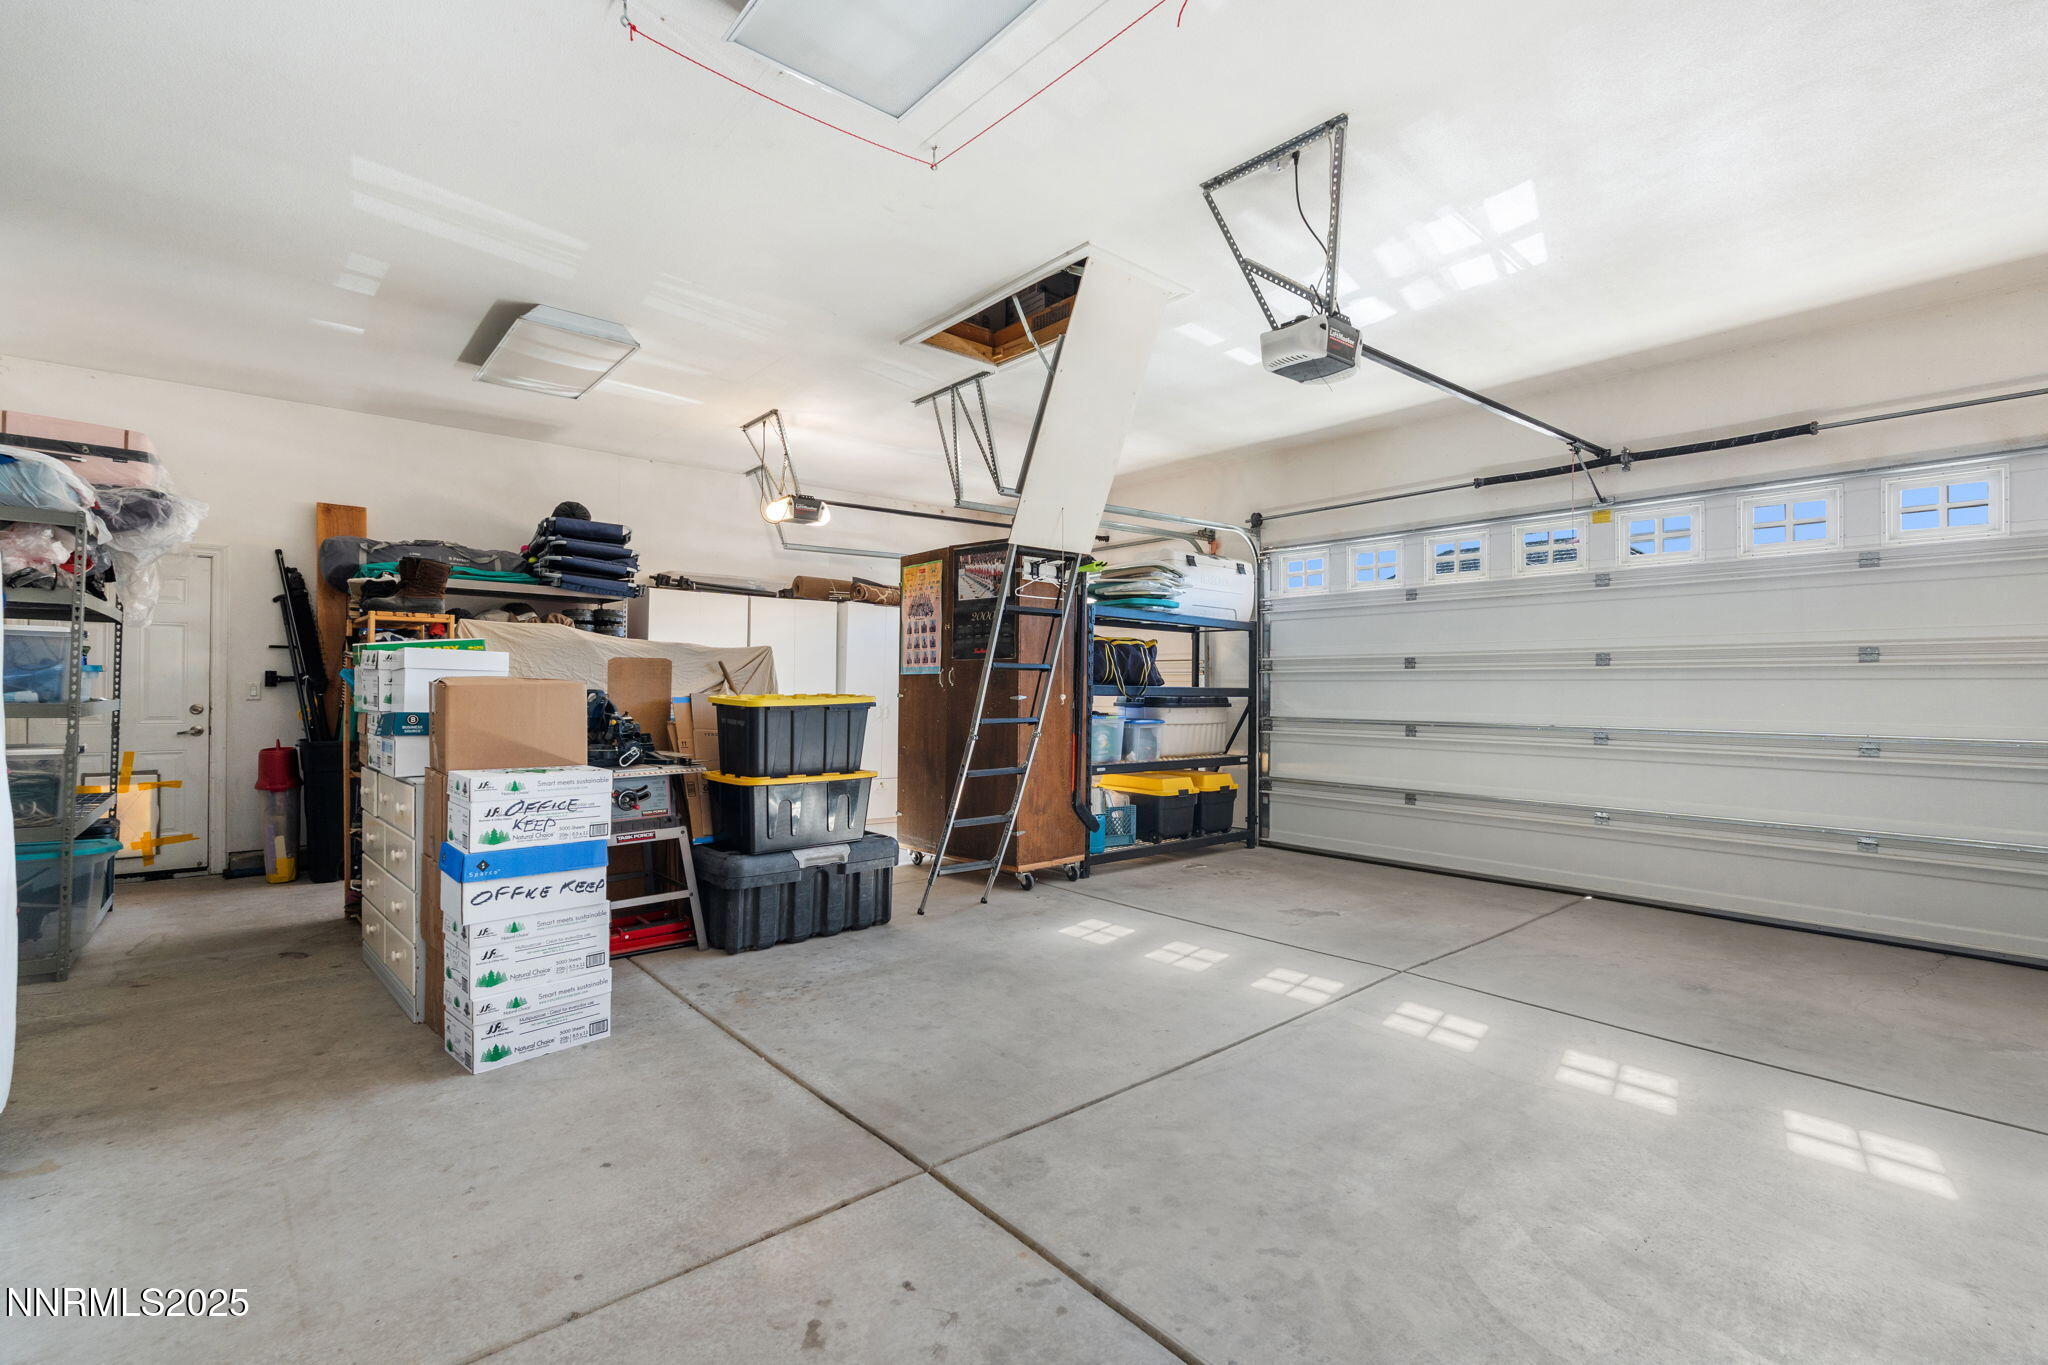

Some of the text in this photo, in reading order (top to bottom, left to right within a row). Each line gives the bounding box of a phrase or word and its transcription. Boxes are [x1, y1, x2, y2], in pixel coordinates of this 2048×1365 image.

[576, 776, 610, 785] sustainable
[505, 798, 580, 817] OFFICE
[512, 815, 557, 833] KEEP
[633, 832, 655, 840] FORCE
[468, 870, 499, 879] Sparco
[559, 878, 605, 895] KEEP
[536, 920, 555, 928] Smart
[575, 909, 608, 920] sustainable
[510, 967, 551, 981] Natural Choice
[538, 991, 557, 1000] Smart
[576, 977, 609, 990] sustainable
[513, 1037, 555, 1053] Natural Choice
